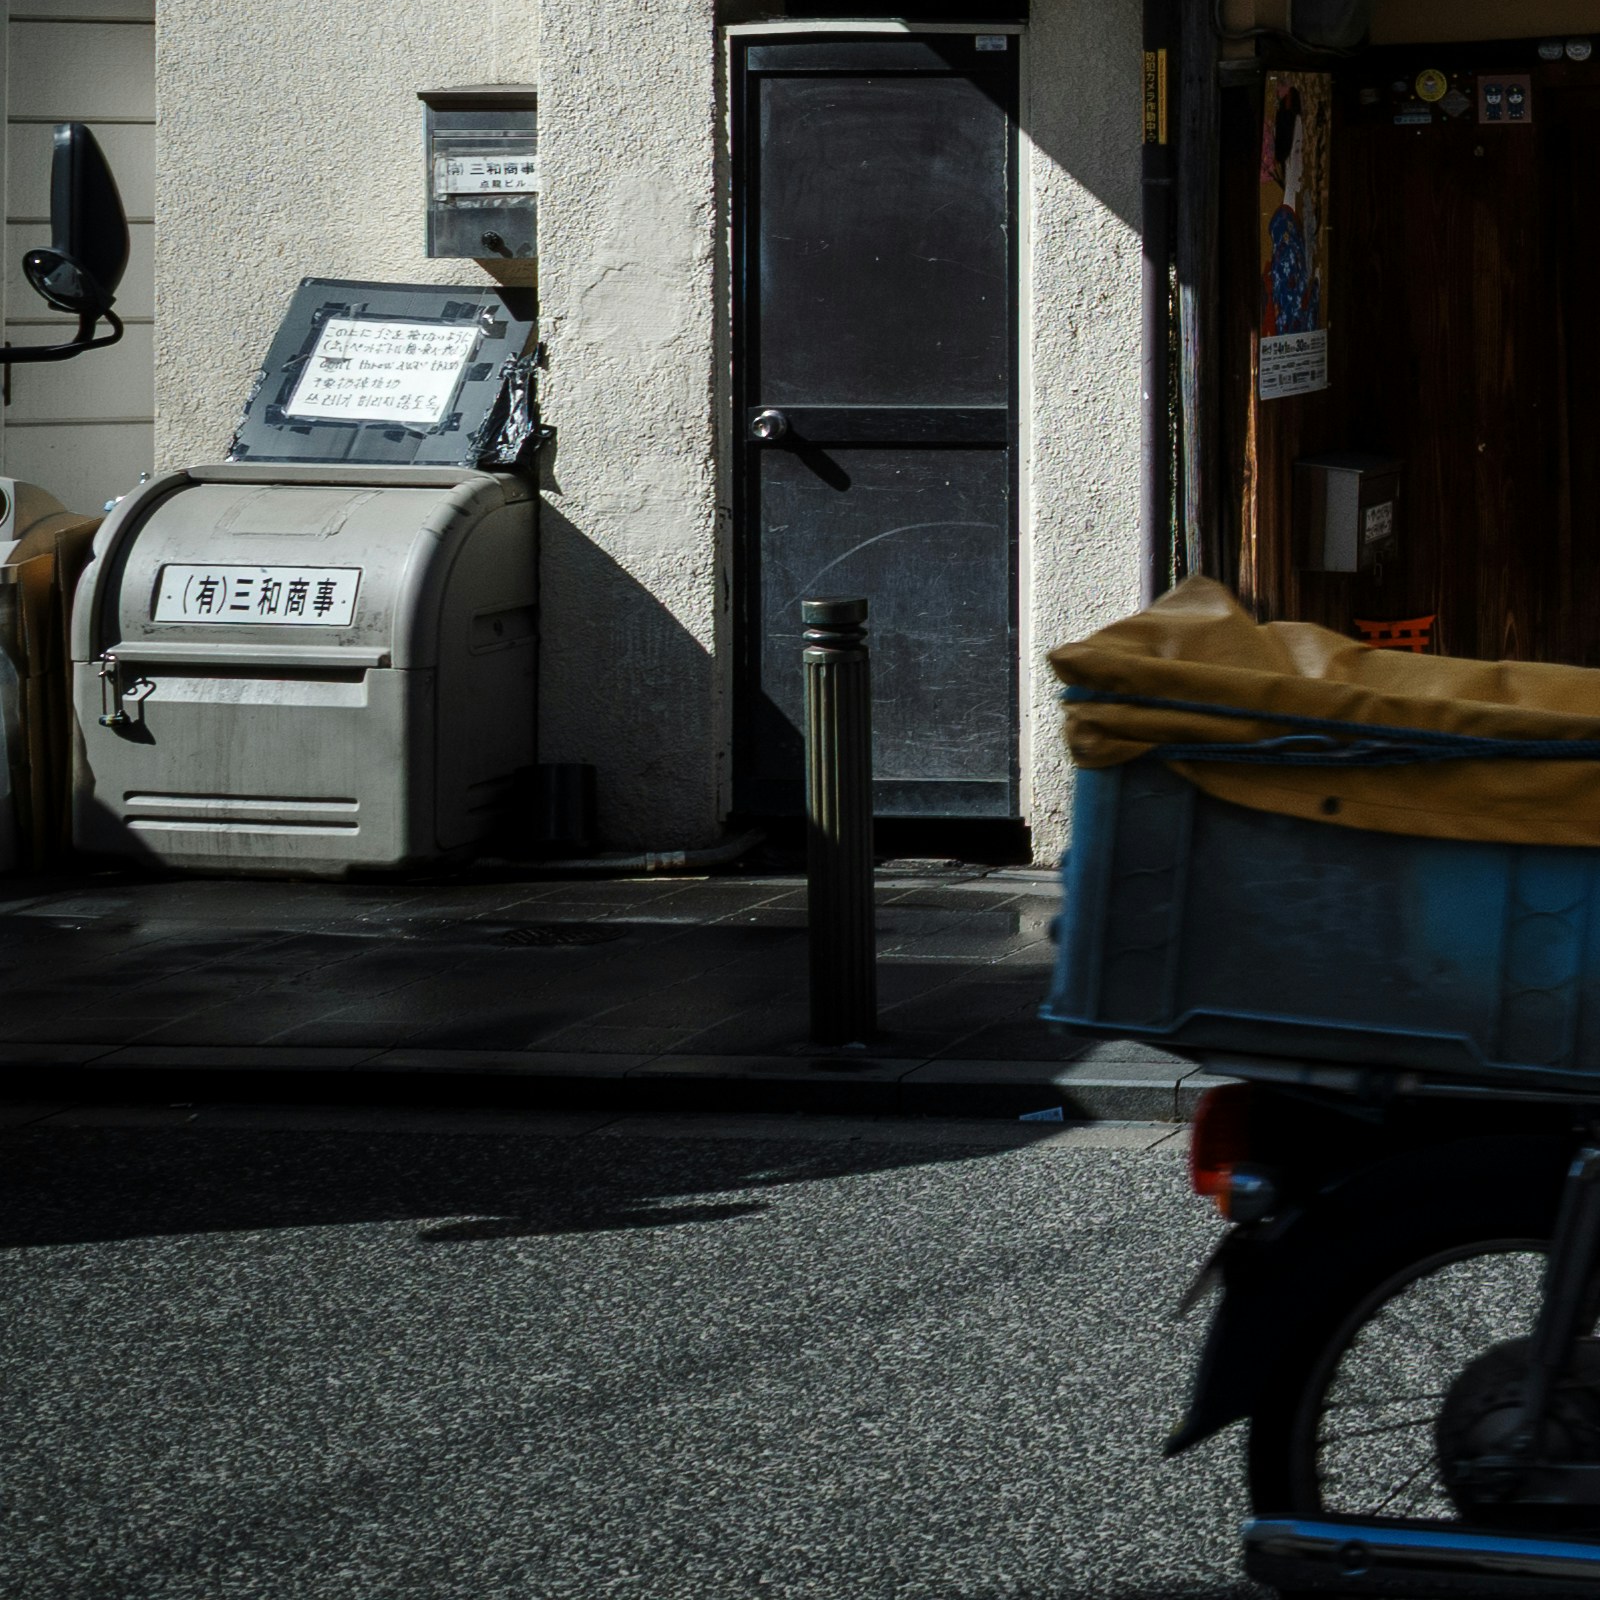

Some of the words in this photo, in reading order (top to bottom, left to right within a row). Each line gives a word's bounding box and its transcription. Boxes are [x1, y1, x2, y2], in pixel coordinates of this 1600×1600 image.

[1145, 51, 1156, 132] 防犯カメラ作動中
[183, 575, 338, 617] (有)三和商事
